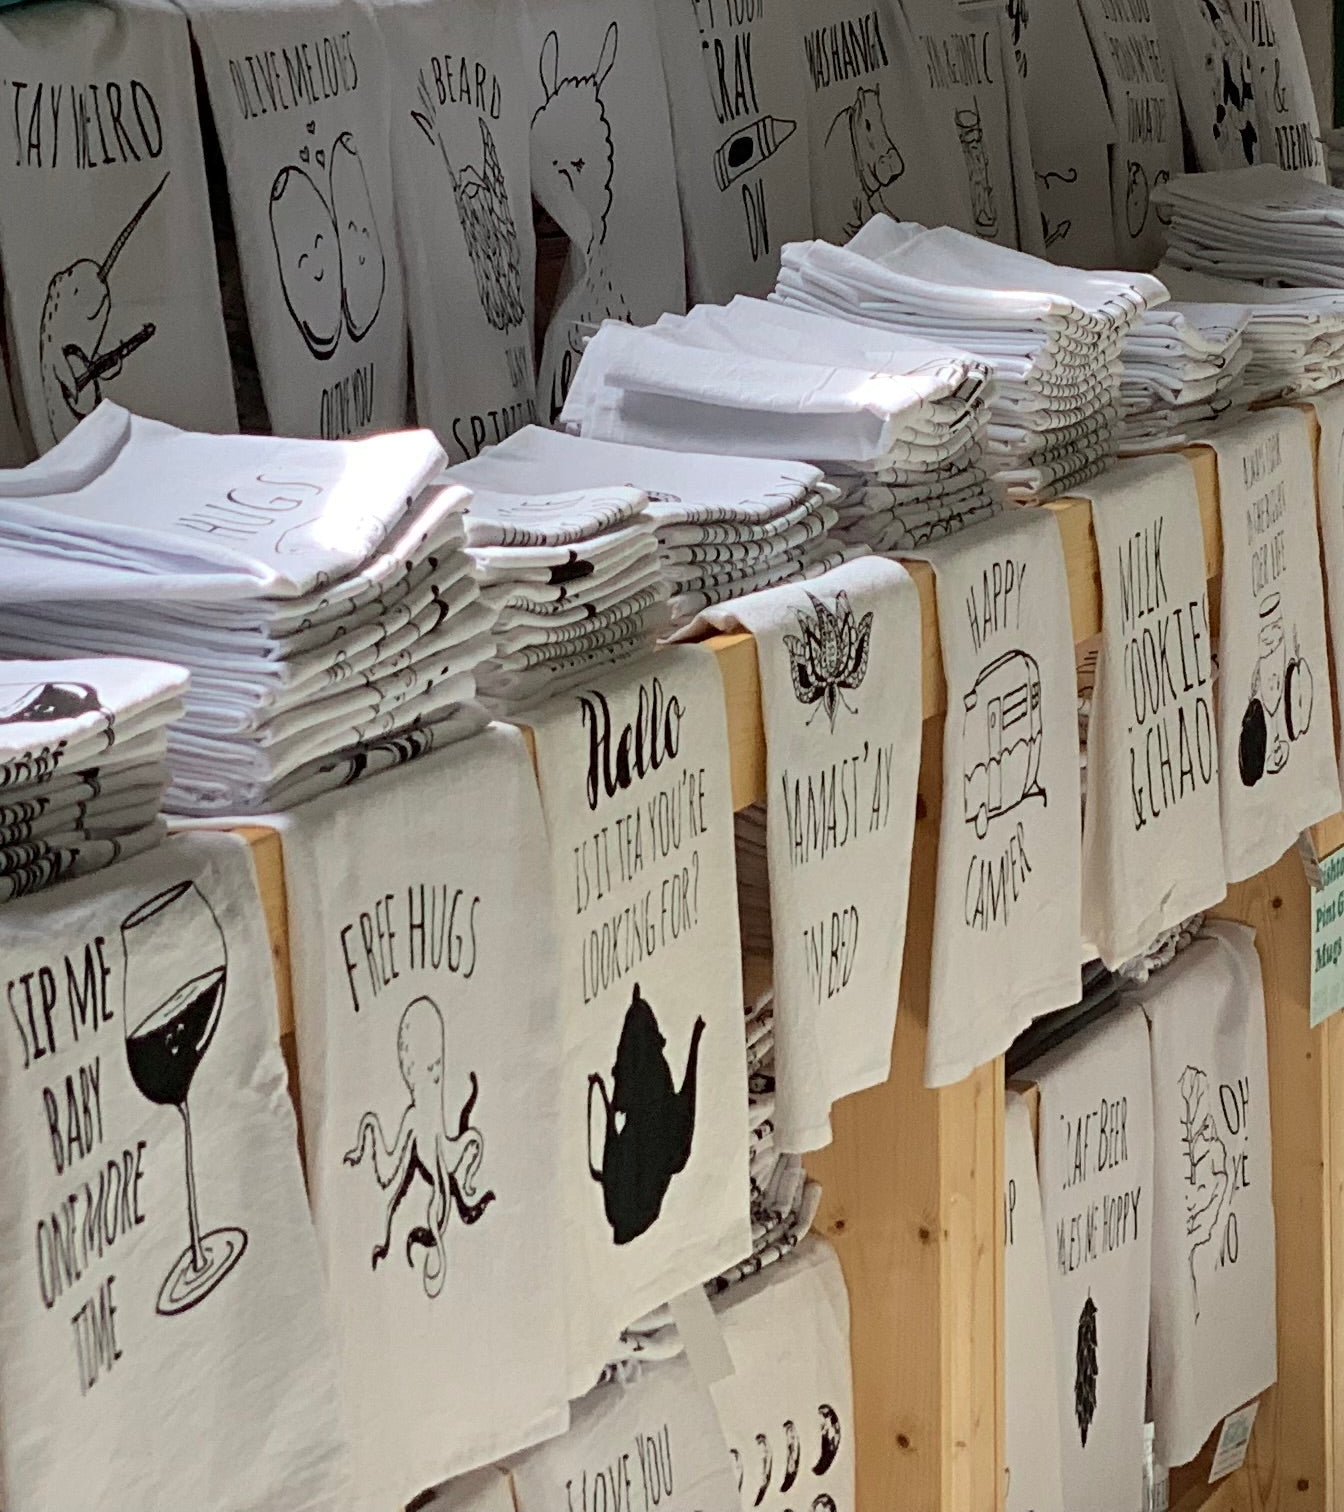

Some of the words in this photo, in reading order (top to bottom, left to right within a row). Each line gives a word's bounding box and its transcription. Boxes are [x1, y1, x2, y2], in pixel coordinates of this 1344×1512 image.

[179, 471, 324, 542] HUGS
[966, 558, 1026, 655] HAPPY
[1118, 515, 1169, 634] MILK
[575, 676, 687, 811] Hello
[573, 840, 591, 915] IS
[593, 826, 612, 901] IT
[614, 805, 645, 883] TEA
[647, 767, 709, 863] YOU'RE
[340, 893, 396, 1013] FREE
[407, 884, 481, 979] HUGS
[582, 889, 656, 1006] LOOKING
[660, 849, 700, 947] FOR?
[826, 904, 860, 1000] BED
[1315, 899, 1337, 934] Pint
[1315, 935, 1343, 973] Mugs
[6, 964, 58, 1071] SIP
[63, 935, 115, 1043] ME
[42, 1054, 104, 1177] BABY
[1097, 1096, 1129, 1172] BEER
[1103, 1185, 1142, 1252] HOPPY
